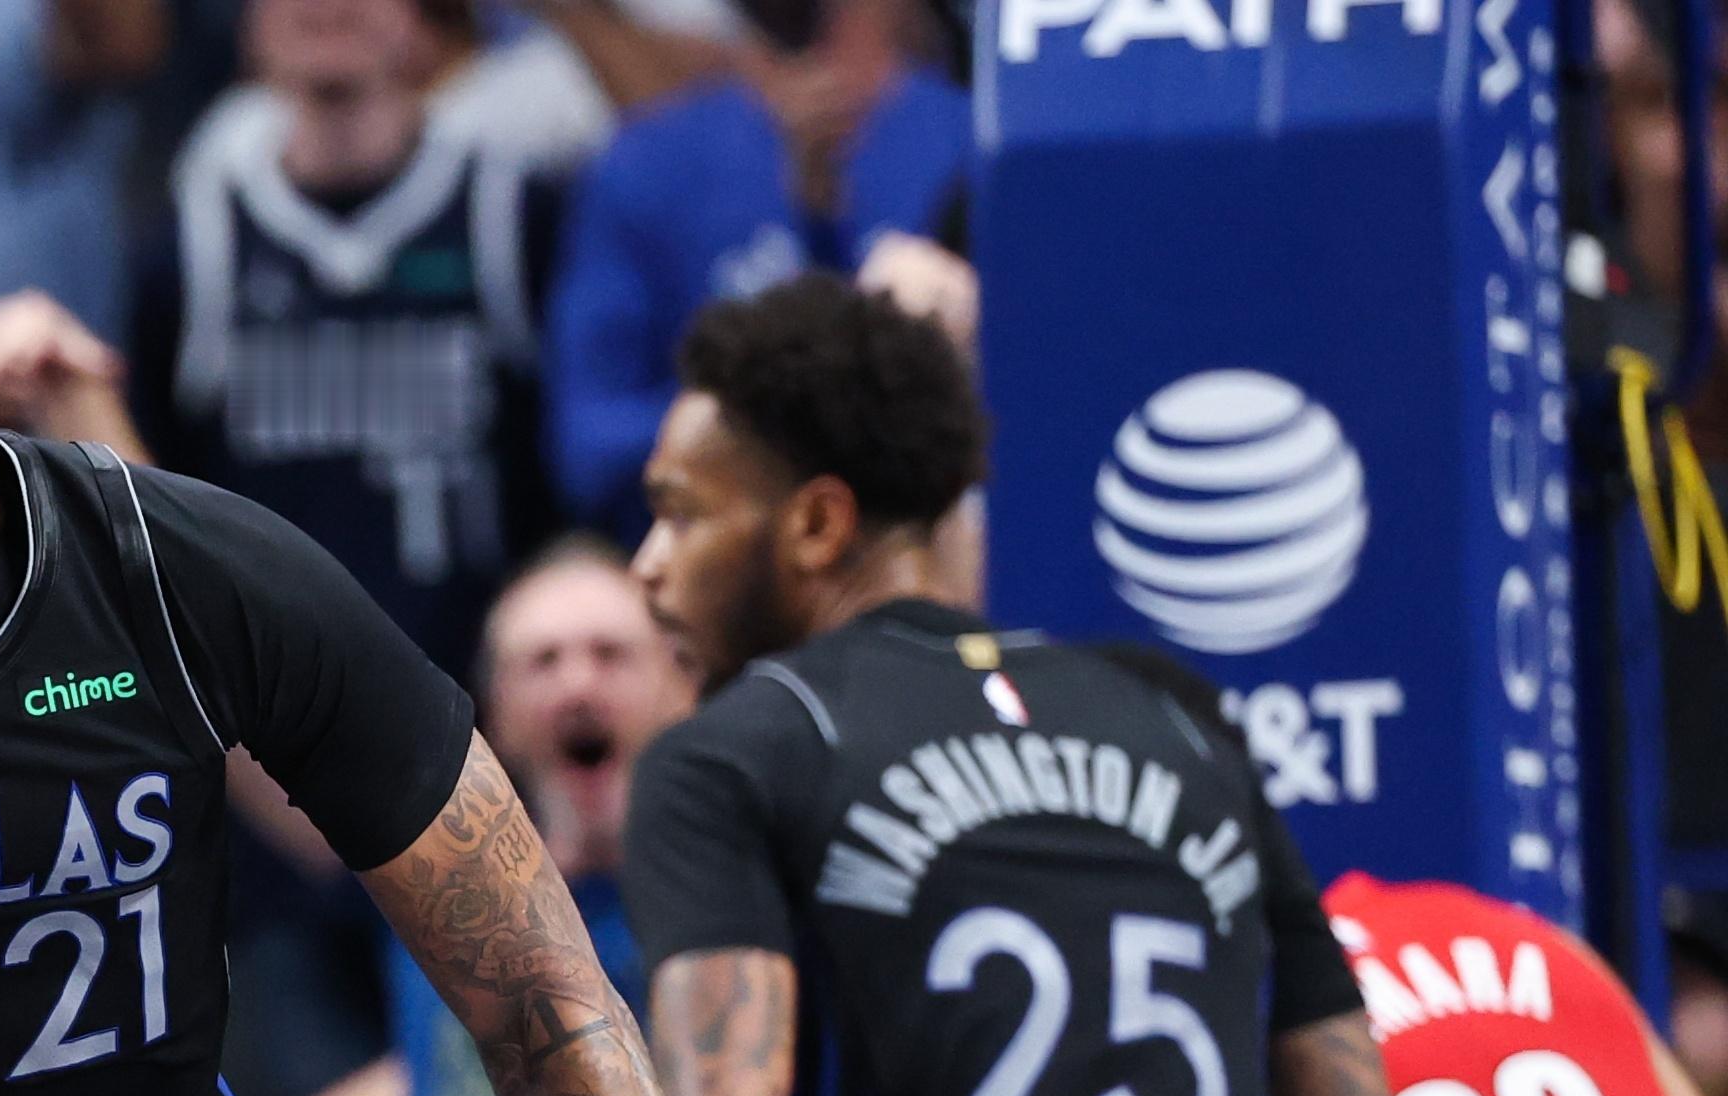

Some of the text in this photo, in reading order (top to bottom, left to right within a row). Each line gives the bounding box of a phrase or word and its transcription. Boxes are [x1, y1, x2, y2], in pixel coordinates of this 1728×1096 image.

[1475, 0, 1554, 905] HOCTAW
[24, 671, 137, 716] chime
[1218, 672, 1405, 808] &T
[815, 731, 1182, 918] WASHINGTON
[3, 884, 167, 1082] 21
[1354, 935, 1554, 1045] MARA
